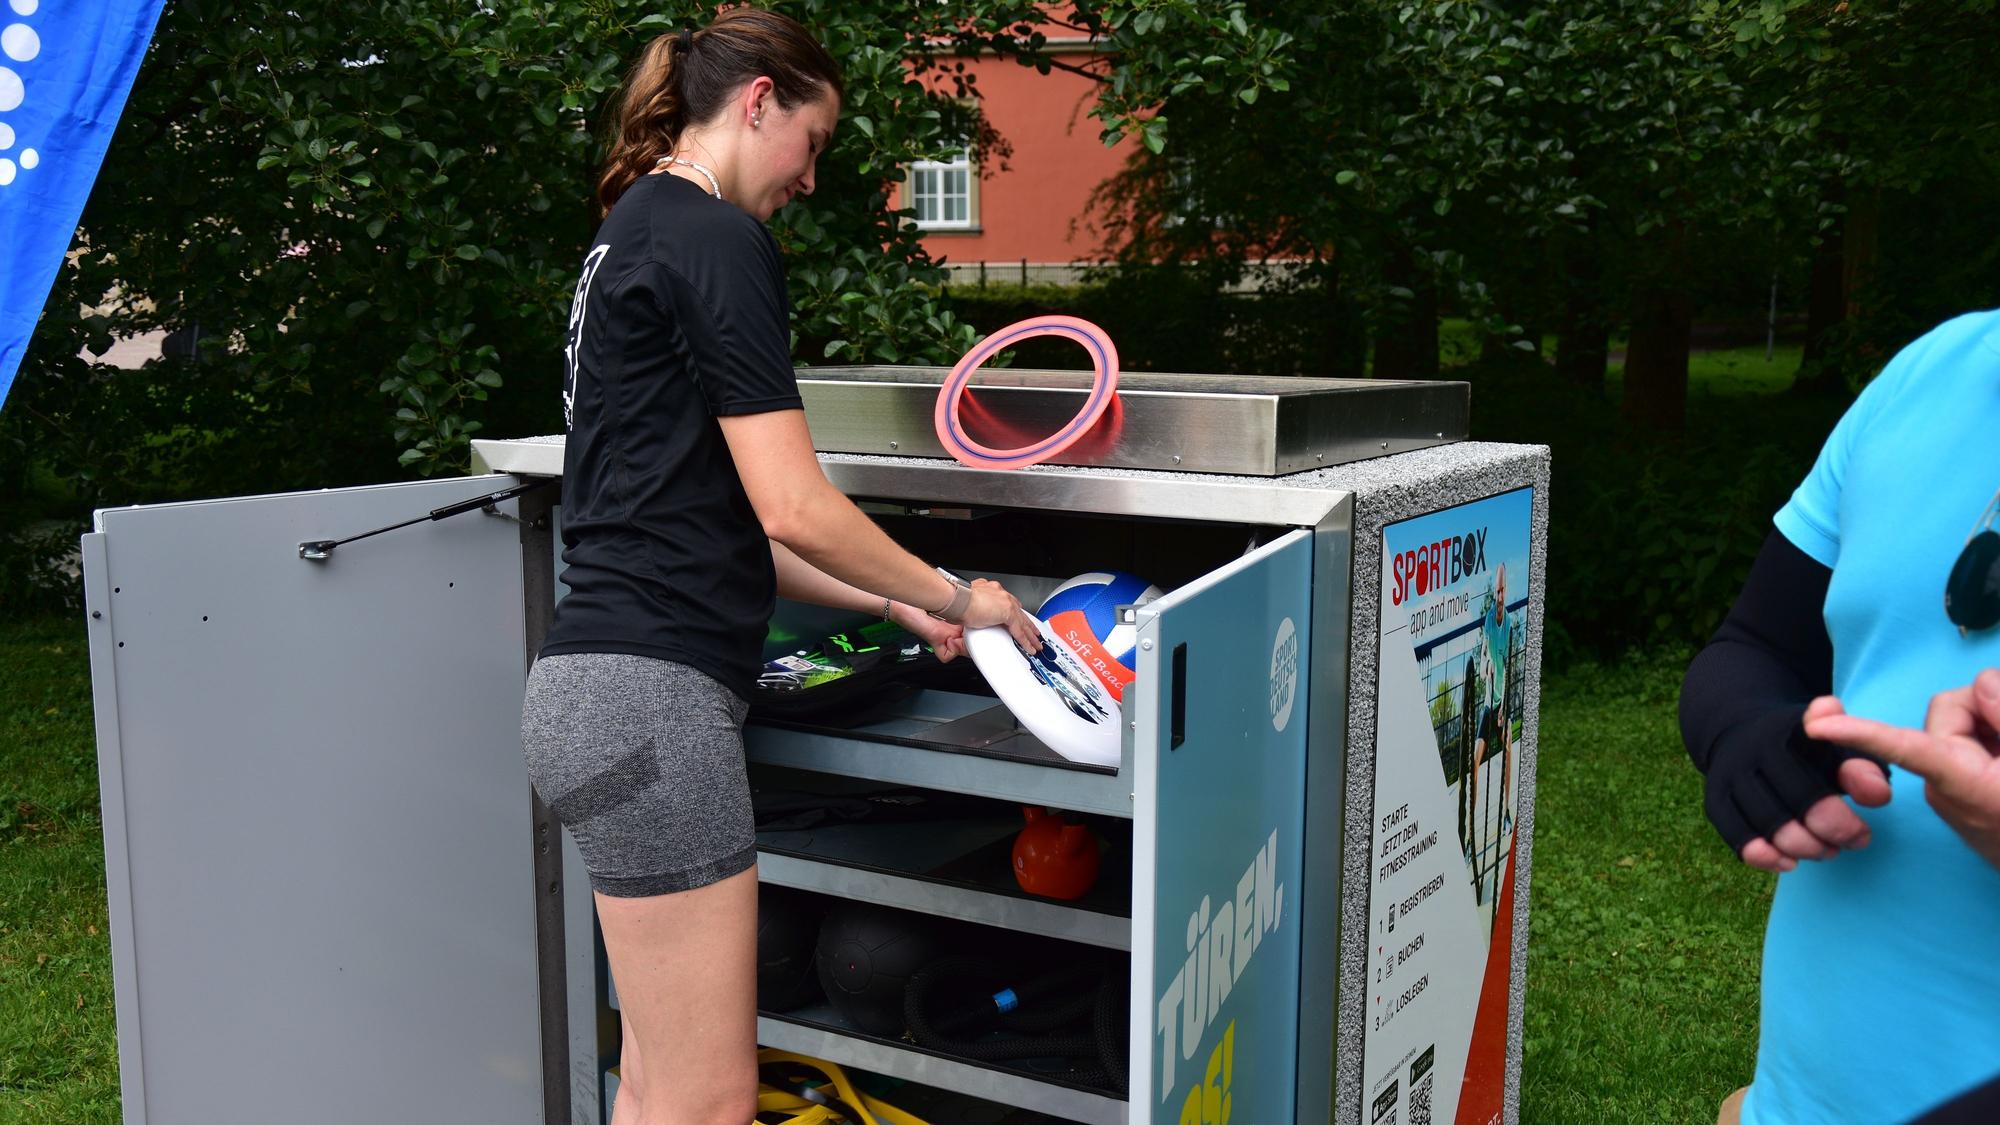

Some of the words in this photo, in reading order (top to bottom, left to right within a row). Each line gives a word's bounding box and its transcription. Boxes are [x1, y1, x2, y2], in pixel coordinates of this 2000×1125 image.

[1392, 527, 1487, 606] SPORTBOX
[1410, 610, 1427, 638] app
[1429, 597, 1445, 627] and
[1447, 591, 1469, 620] move
[1065, 630, 1093, 657] Soft
[1091, 656, 1123, 691] Beac
[1275, 632, 1297, 672] SPORT
[1380, 831, 1402, 858] JETZT
[1403, 820, 1419, 843] DEIN
[1382, 803, 1408, 833] STARTE
[1379, 830, 1437, 884] FITNESSTRAINING
[1379, 919, 1383, 934] 1
[1400, 872, 1445, 918] REGISTRIEREN
[1158, 827, 1284, 1105] TÜREN,
[1376, 967, 1382, 984] 2
[1397, 932, 1425, 966] BUCHEN
[1375, 1016, 1380, 1032] 3
[1396, 972, 1429, 1013] LOSLEGEN
